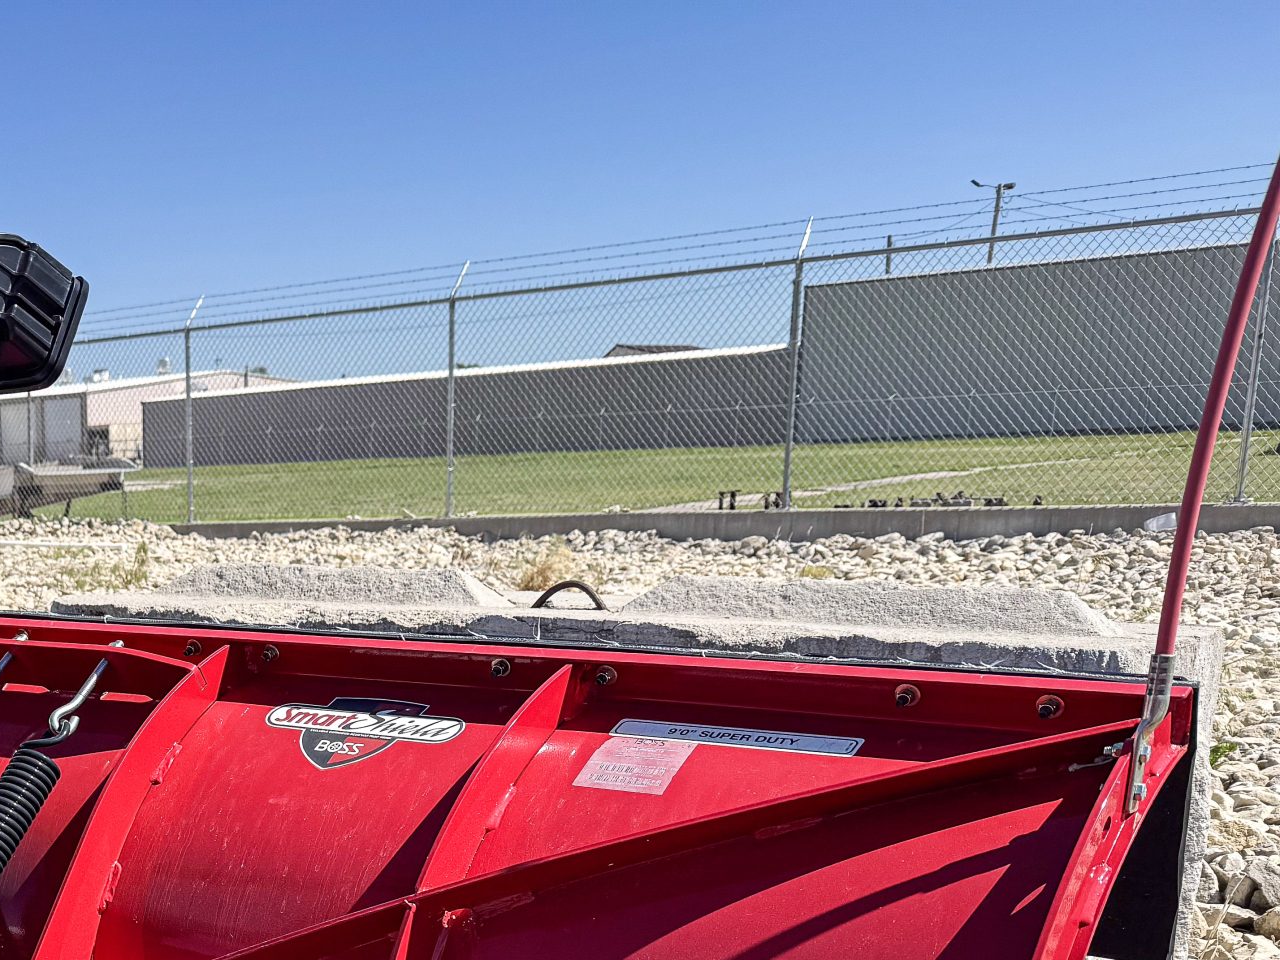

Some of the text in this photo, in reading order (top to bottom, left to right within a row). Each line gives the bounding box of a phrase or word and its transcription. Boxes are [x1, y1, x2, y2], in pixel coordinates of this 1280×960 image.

[699, 730, 753, 742] SUPER
[754, 735, 801, 746] DUTY
[314, 739, 364, 755] BOSS
